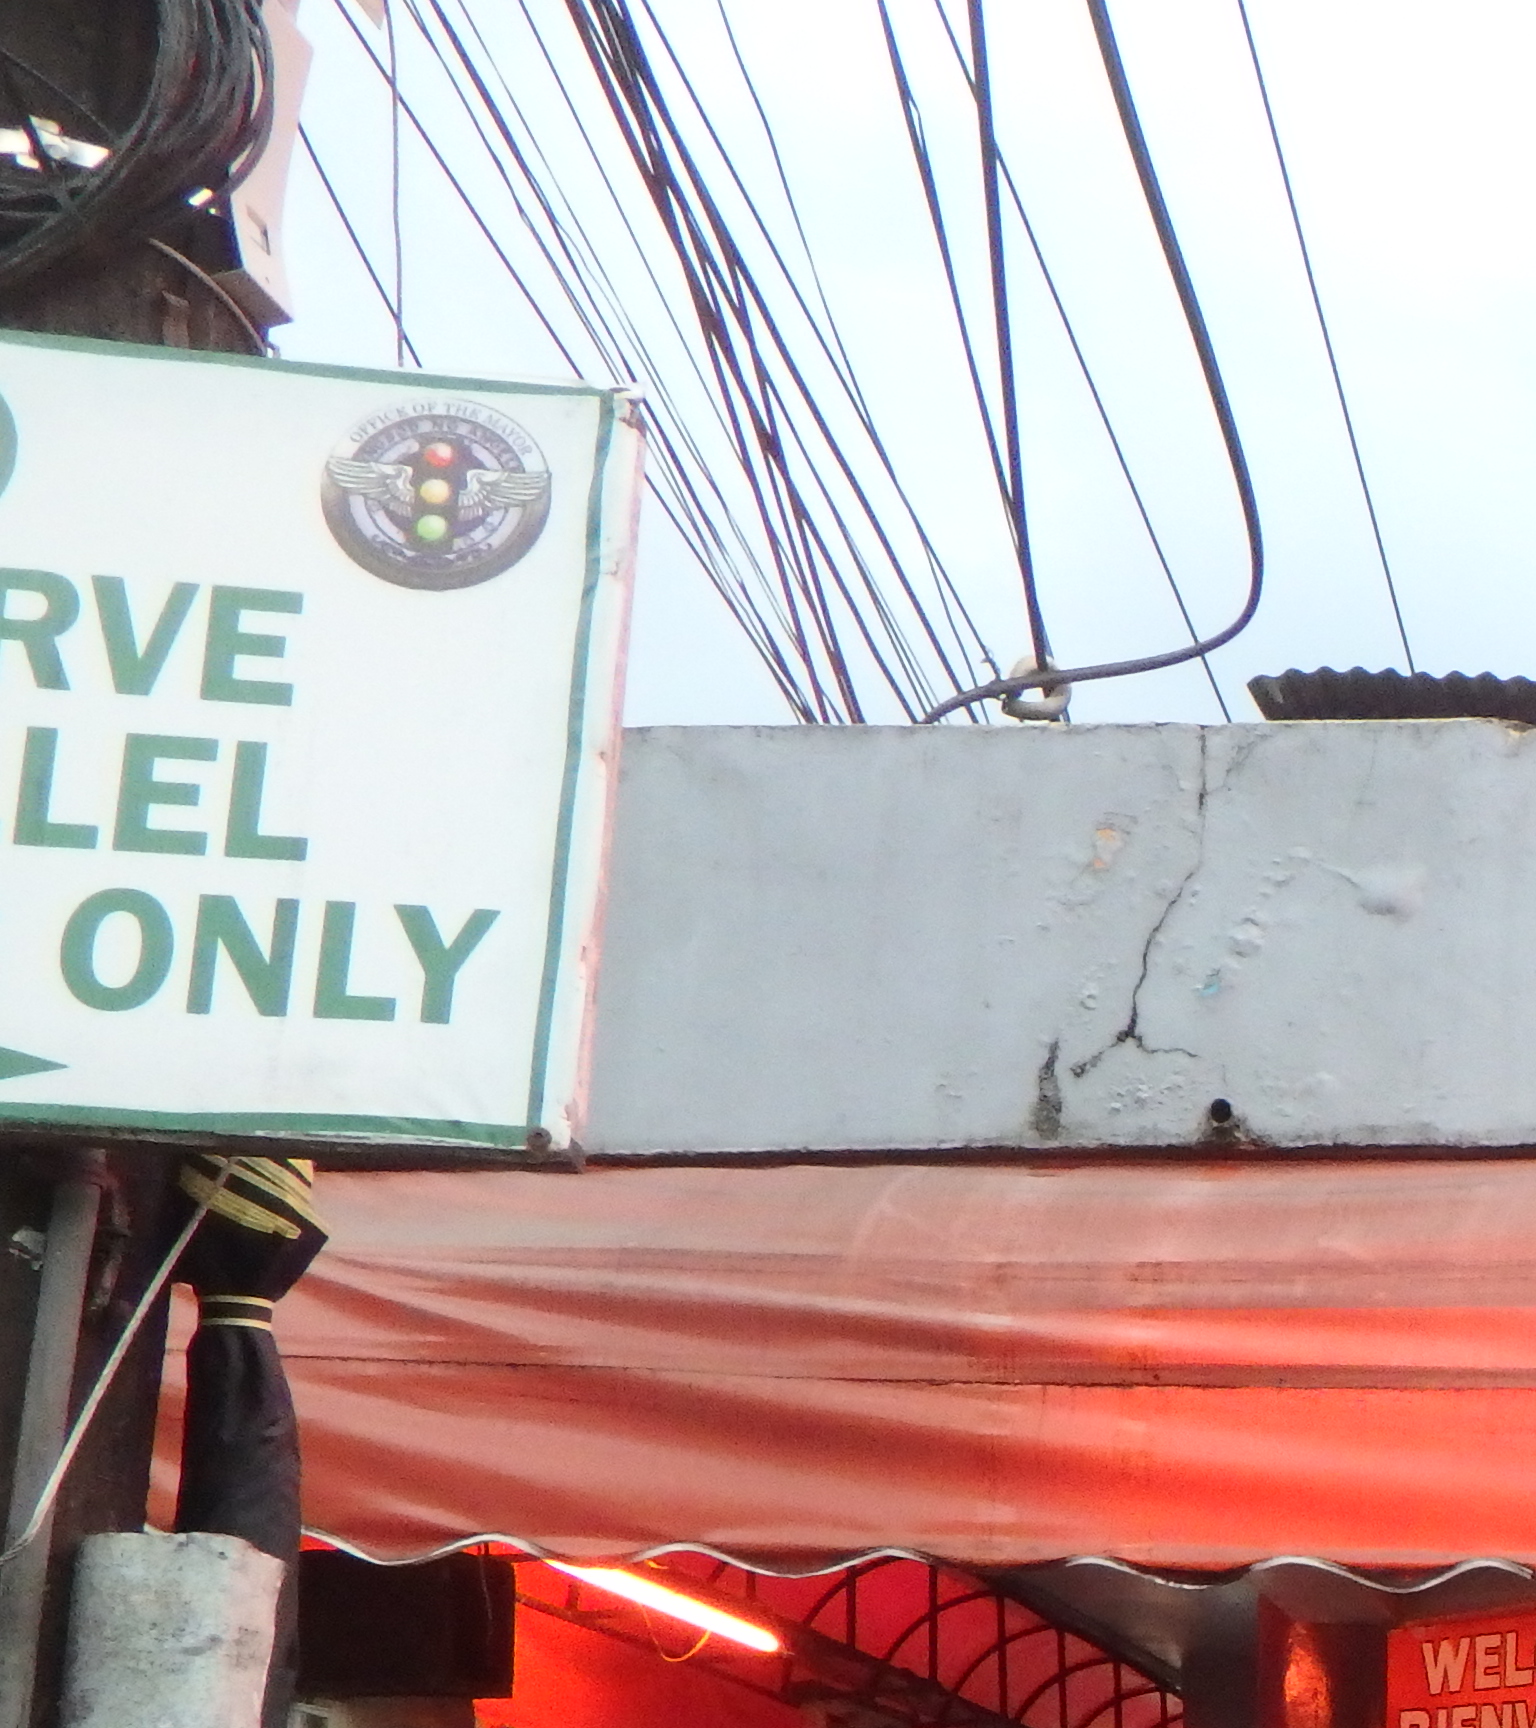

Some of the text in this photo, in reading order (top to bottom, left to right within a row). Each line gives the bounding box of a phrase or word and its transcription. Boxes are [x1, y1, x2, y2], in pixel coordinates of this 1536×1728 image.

[349, 405, 409, 444] OFFICE
[412, 402, 439, 416] OF
[443, 402, 479, 420] THE
[482, 410, 533, 457] MAYOR
[13, 726, 309, 862] LEL
[59, 888, 502, 1025] ONLY
